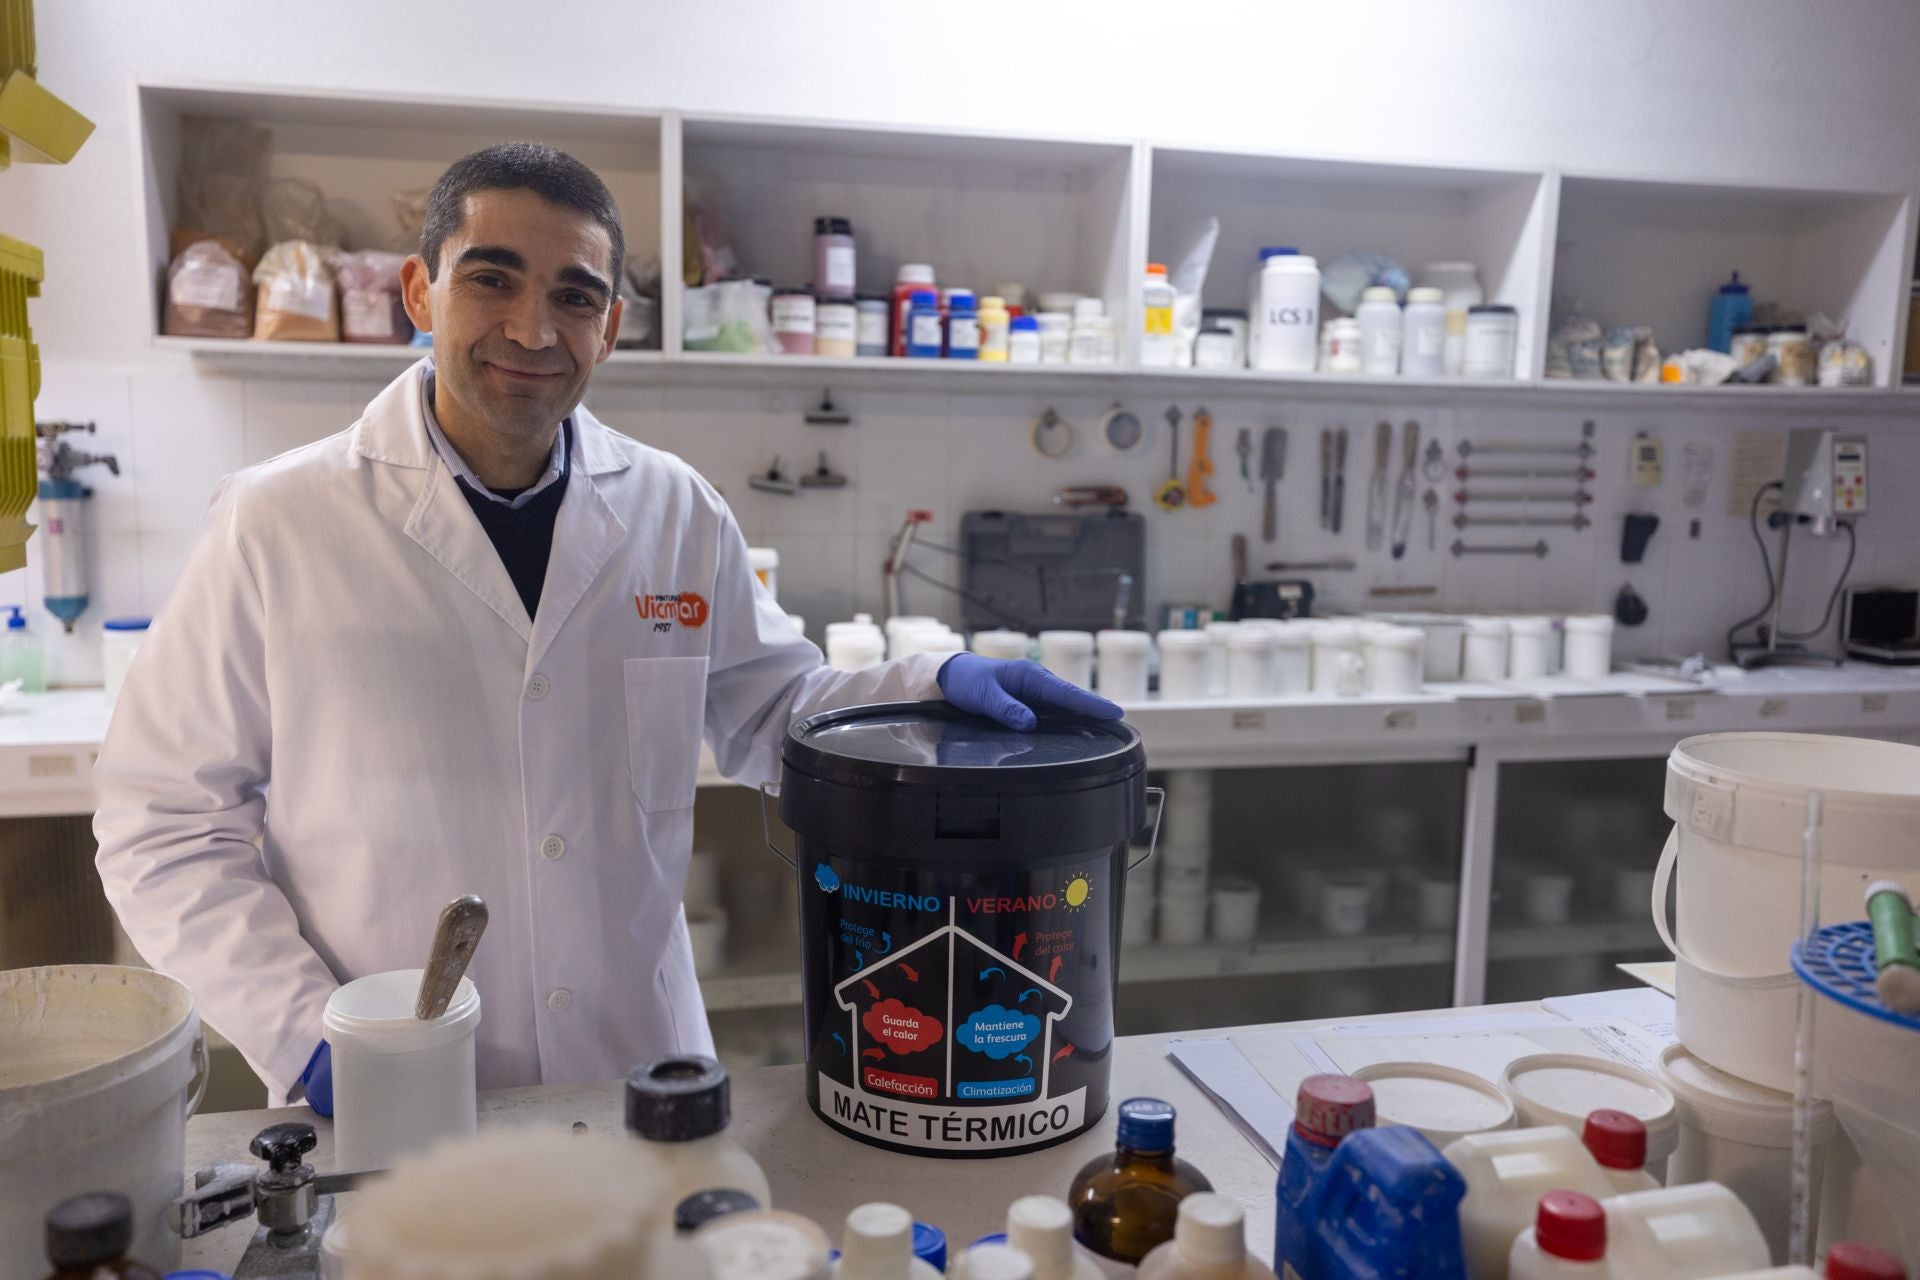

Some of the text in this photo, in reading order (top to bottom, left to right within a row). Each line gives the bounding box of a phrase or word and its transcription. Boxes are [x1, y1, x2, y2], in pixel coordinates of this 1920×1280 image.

[1270, 308, 1300, 325] LCS
[635, 594, 700, 619] Vicmar
[843, 883, 940, 912] INVIERNO
[967, 894, 1056, 913] VERANO
[840, 918, 875, 937] Protege
[841, 932, 854, 945] del
[1035, 928, 1073, 943] Protege
[1035, 941, 1074, 956] del calor
[882, 1014, 919, 1028] Guarda
[975, 1020, 1024, 1031] Mantiene
[883, 1026, 918, 1041] el calor
[975, 1032, 1026, 1044] la frescura
[868, 1074, 933, 1095] Calefacción
[963, 1082, 1032, 1096] Climatización
[834, 1092, 1069, 1141] MATE TÉRMICO
